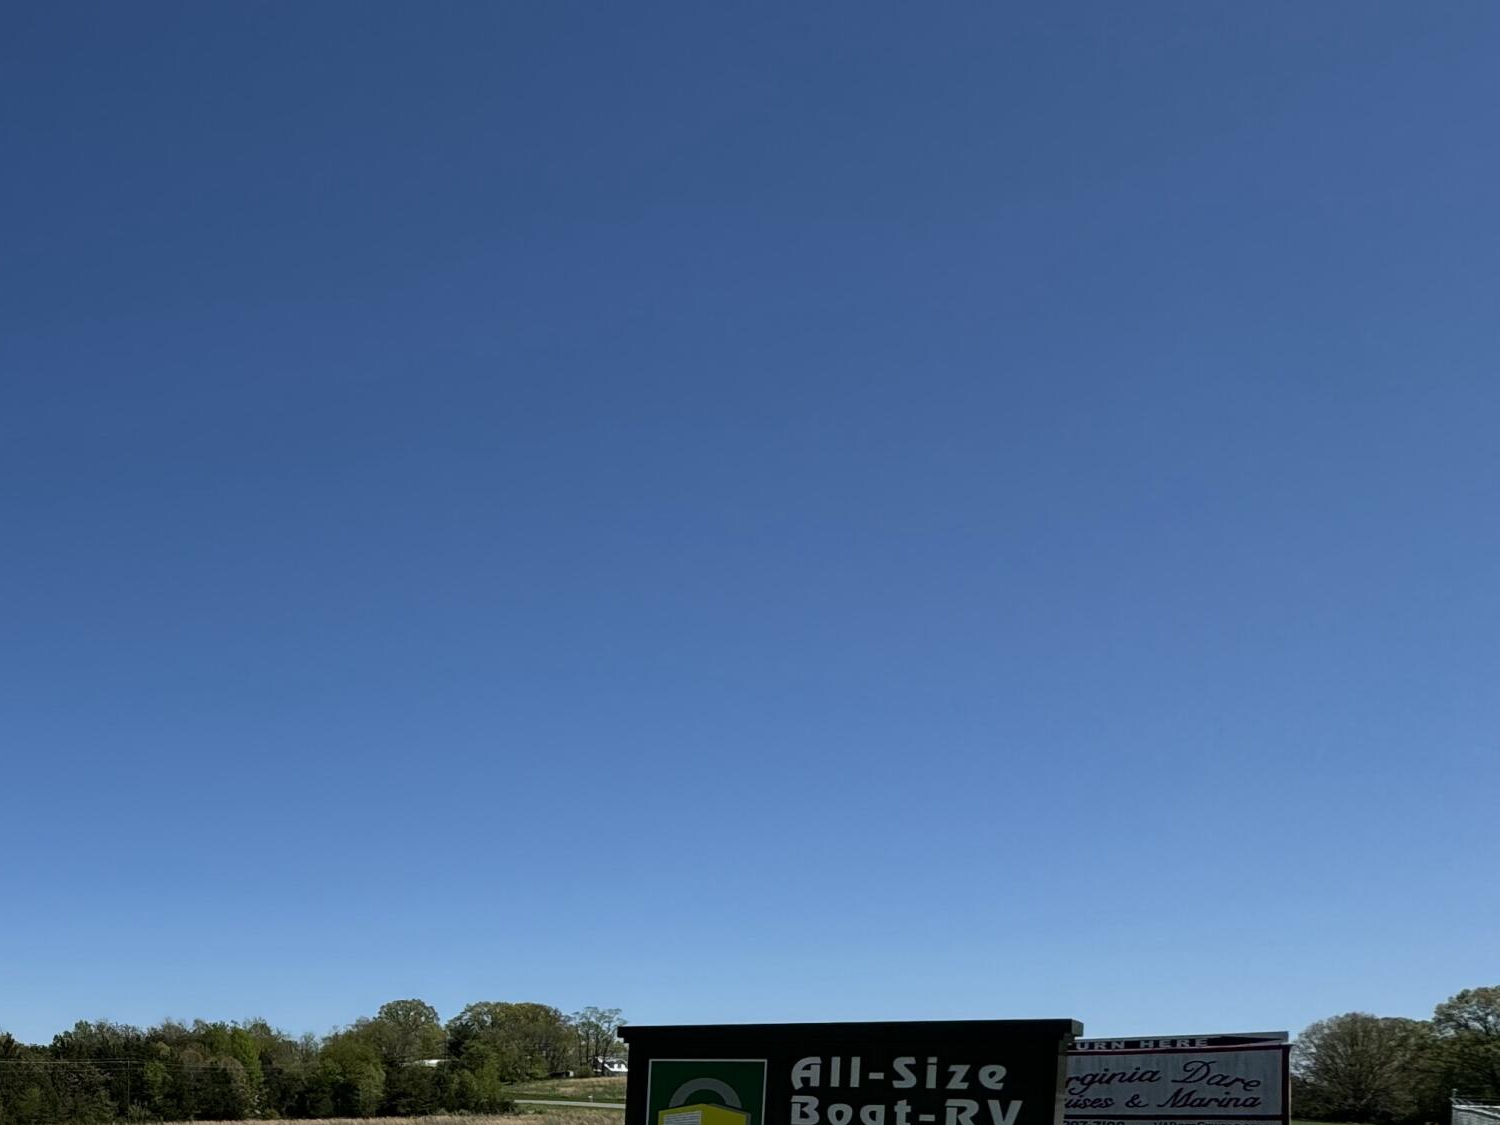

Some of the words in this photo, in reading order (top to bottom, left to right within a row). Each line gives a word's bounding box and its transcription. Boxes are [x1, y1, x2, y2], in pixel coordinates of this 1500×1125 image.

[1068, 1040, 1125, 1050] URN
[1139, 1038, 1207, 1049] HERE
[791, 1056, 1007, 1090] All-Size
[1065, 1067, 1162, 1095] rginia
[1171, 1060, 1261, 1091] Dare
[1064, 1095, 1115, 1109] uises
[1125, 1094, 1148, 1108] &
[1157, 1088, 1262, 1108] Marina
